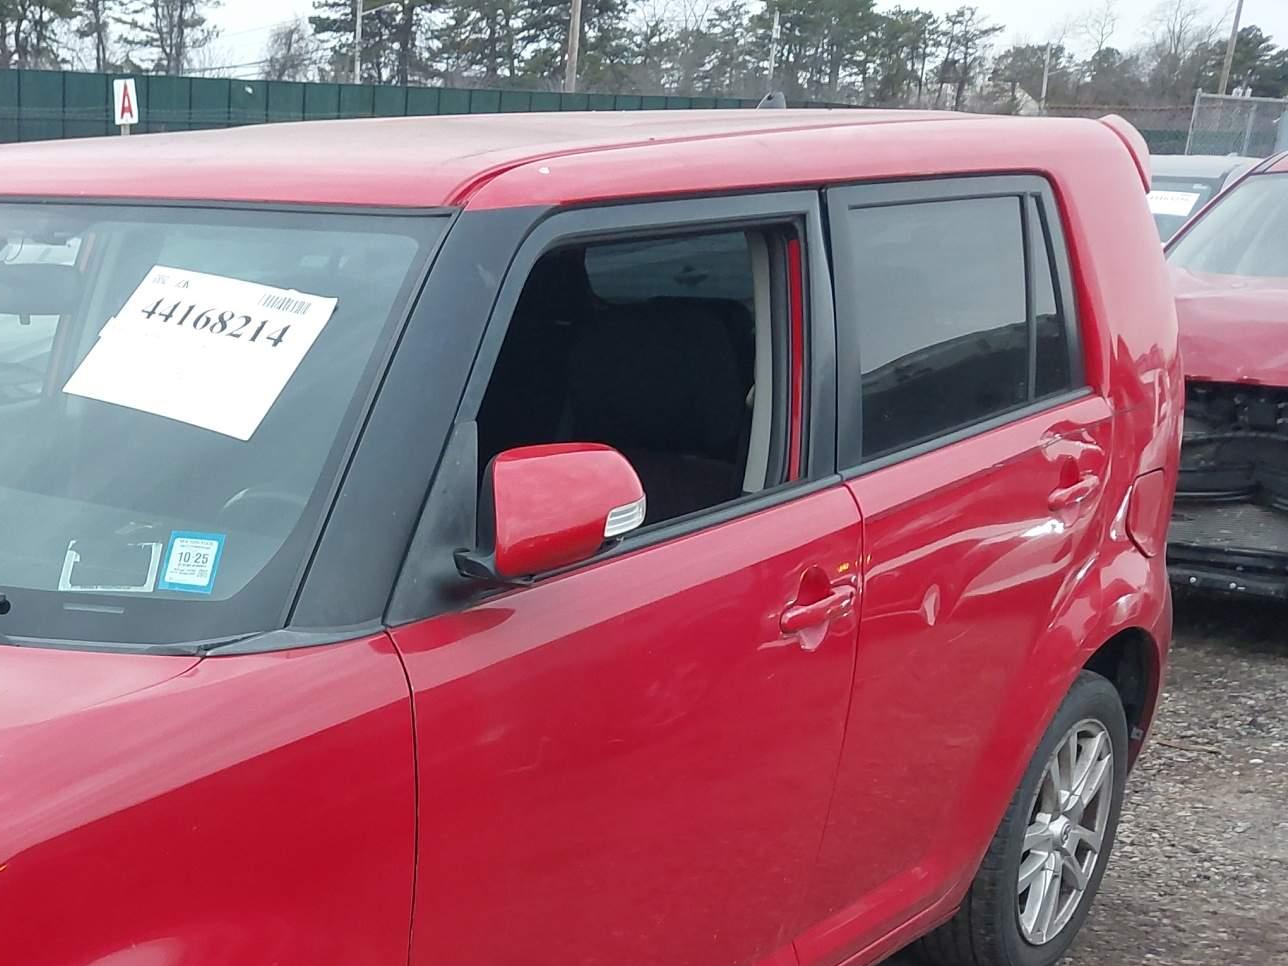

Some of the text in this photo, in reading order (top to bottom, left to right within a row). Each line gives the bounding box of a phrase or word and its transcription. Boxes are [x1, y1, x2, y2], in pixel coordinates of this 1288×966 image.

[120, 80, 134, 119] A
[140, 297, 291, 348] 44168214
[177, 551, 209, 564] 10 25
